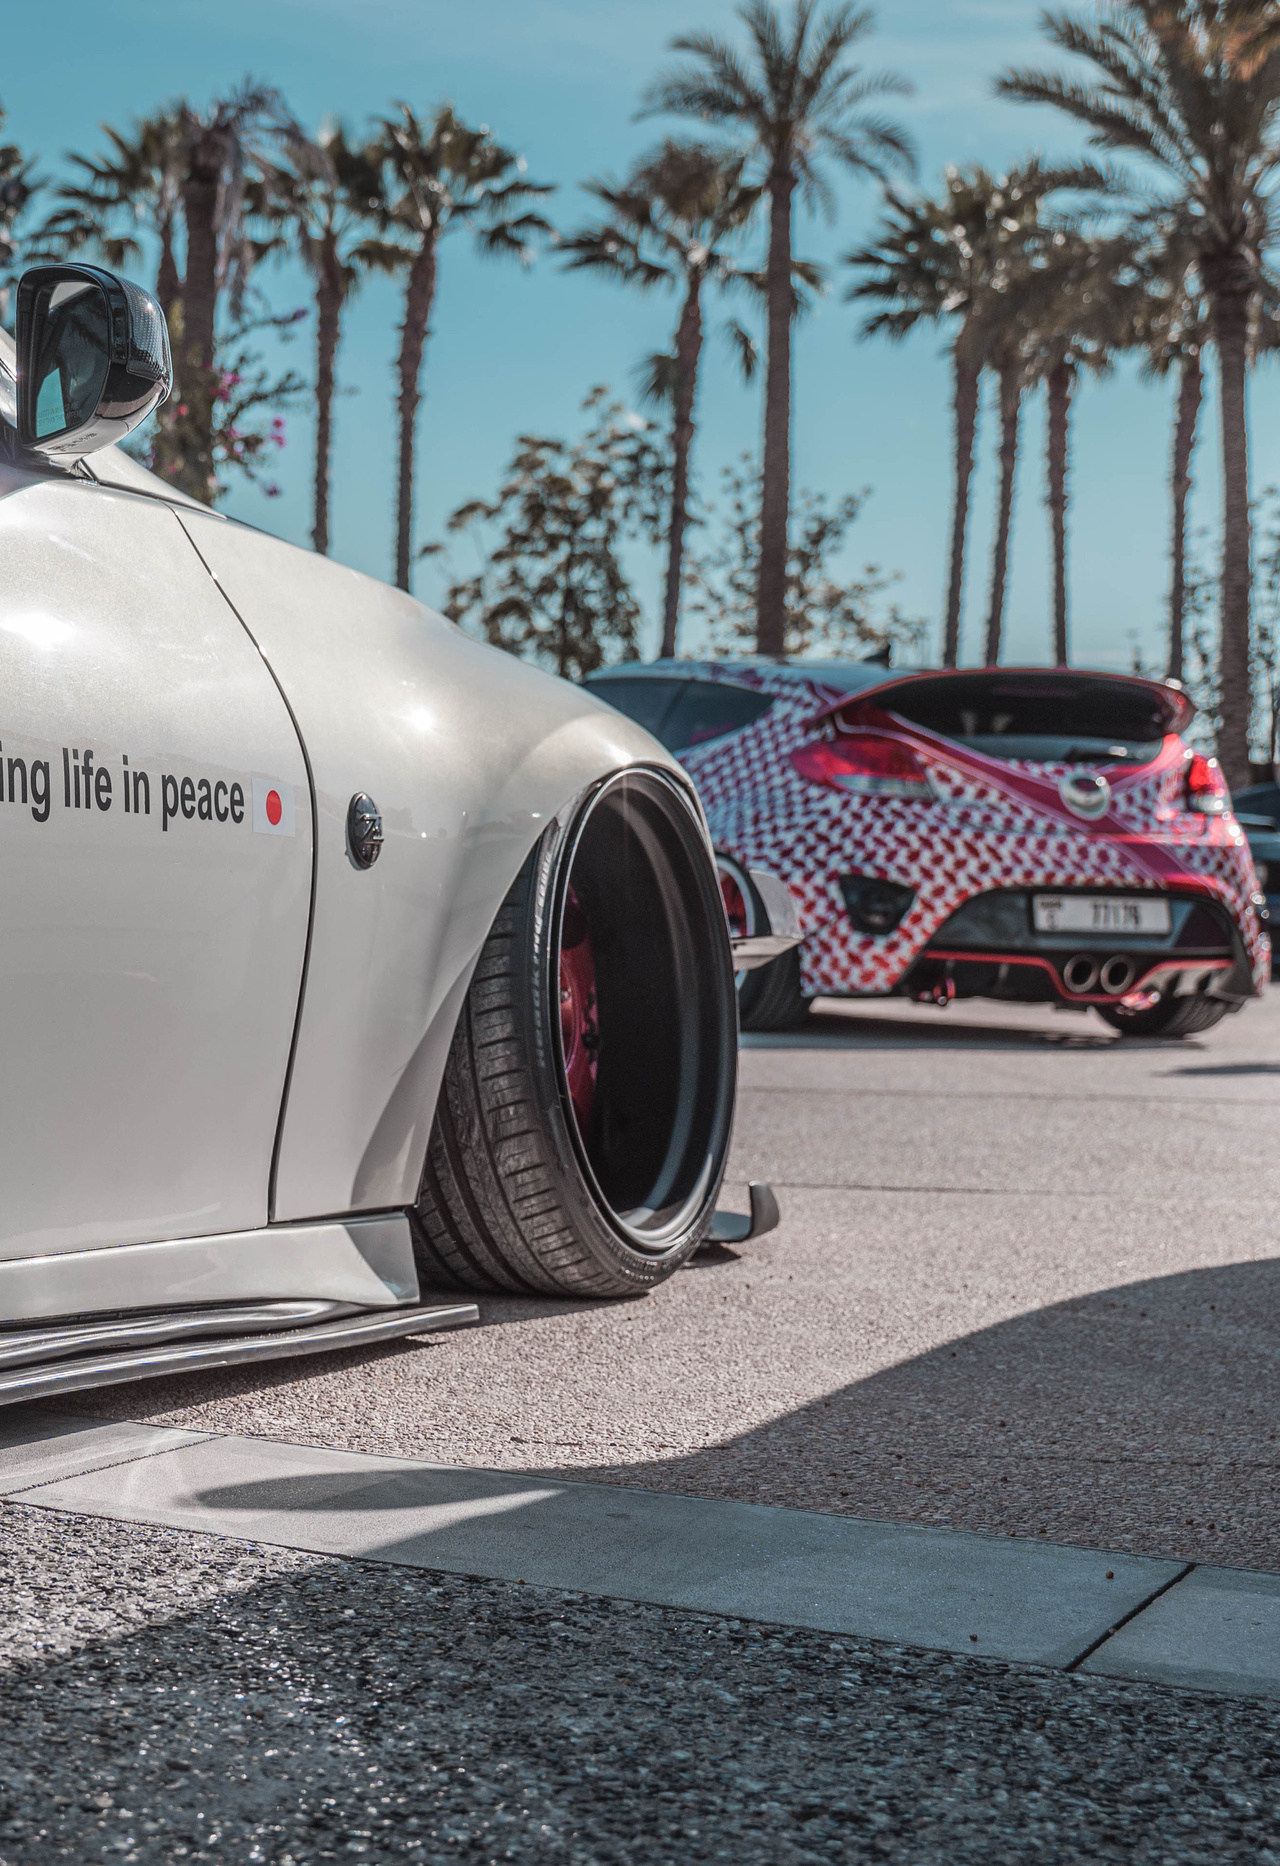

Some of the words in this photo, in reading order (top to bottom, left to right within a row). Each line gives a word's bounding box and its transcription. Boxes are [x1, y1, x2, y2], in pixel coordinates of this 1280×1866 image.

[62, 747, 113, 812] life
[122, 754, 151, 815] in
[161, 774, 245, 832] peace
